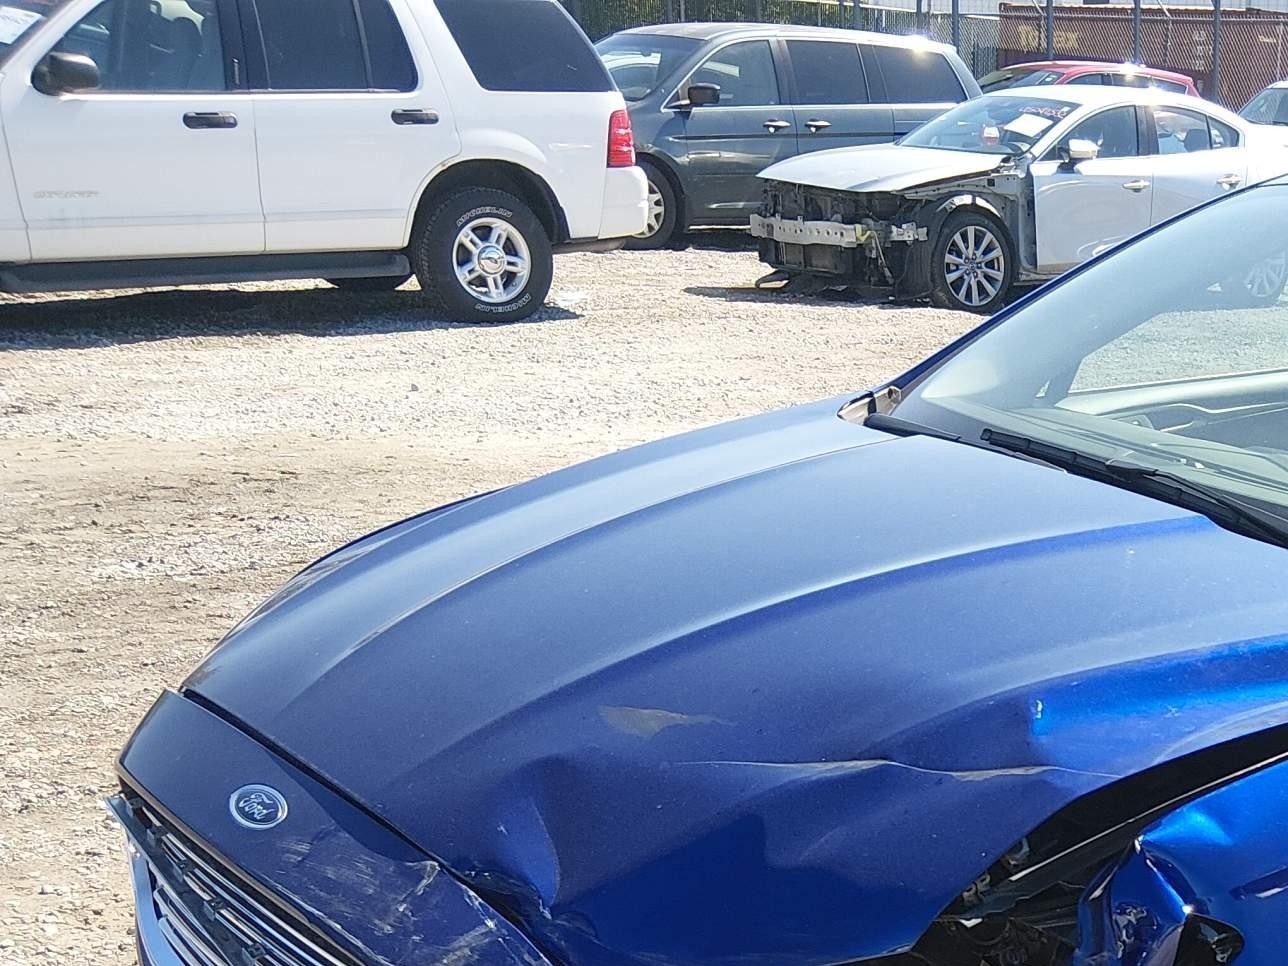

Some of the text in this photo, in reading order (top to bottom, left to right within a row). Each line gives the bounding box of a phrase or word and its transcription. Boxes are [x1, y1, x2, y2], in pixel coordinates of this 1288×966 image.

[457, 206, 513, 227] MICHELIN
[475, 293, 532, 313] MICHELIN
[238, 792, 277, 820] Ford
